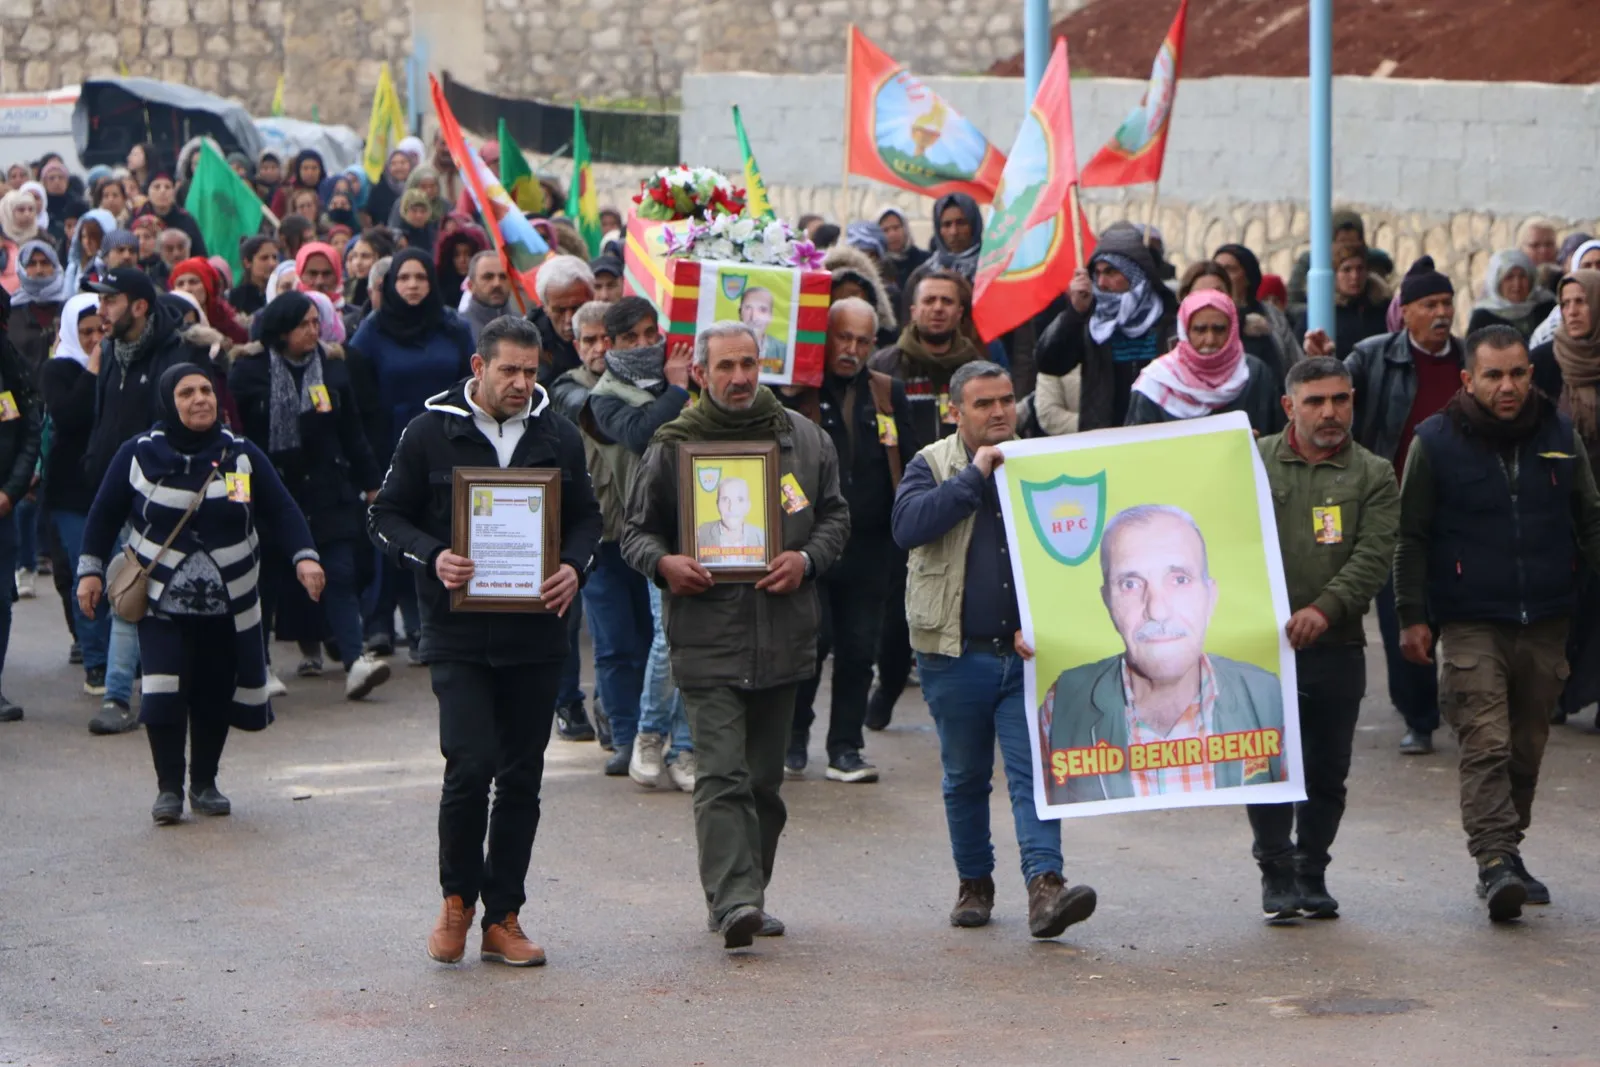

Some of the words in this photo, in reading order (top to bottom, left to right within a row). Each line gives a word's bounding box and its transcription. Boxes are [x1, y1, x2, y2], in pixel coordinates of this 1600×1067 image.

[1051, 517, 1089, 535] HPC
[1051, 739, 1125, 785] ŞEHÎD
[1130, 737, 1202, 771] BEKIR
[1207, 728, 1281, 763] BEKIR
